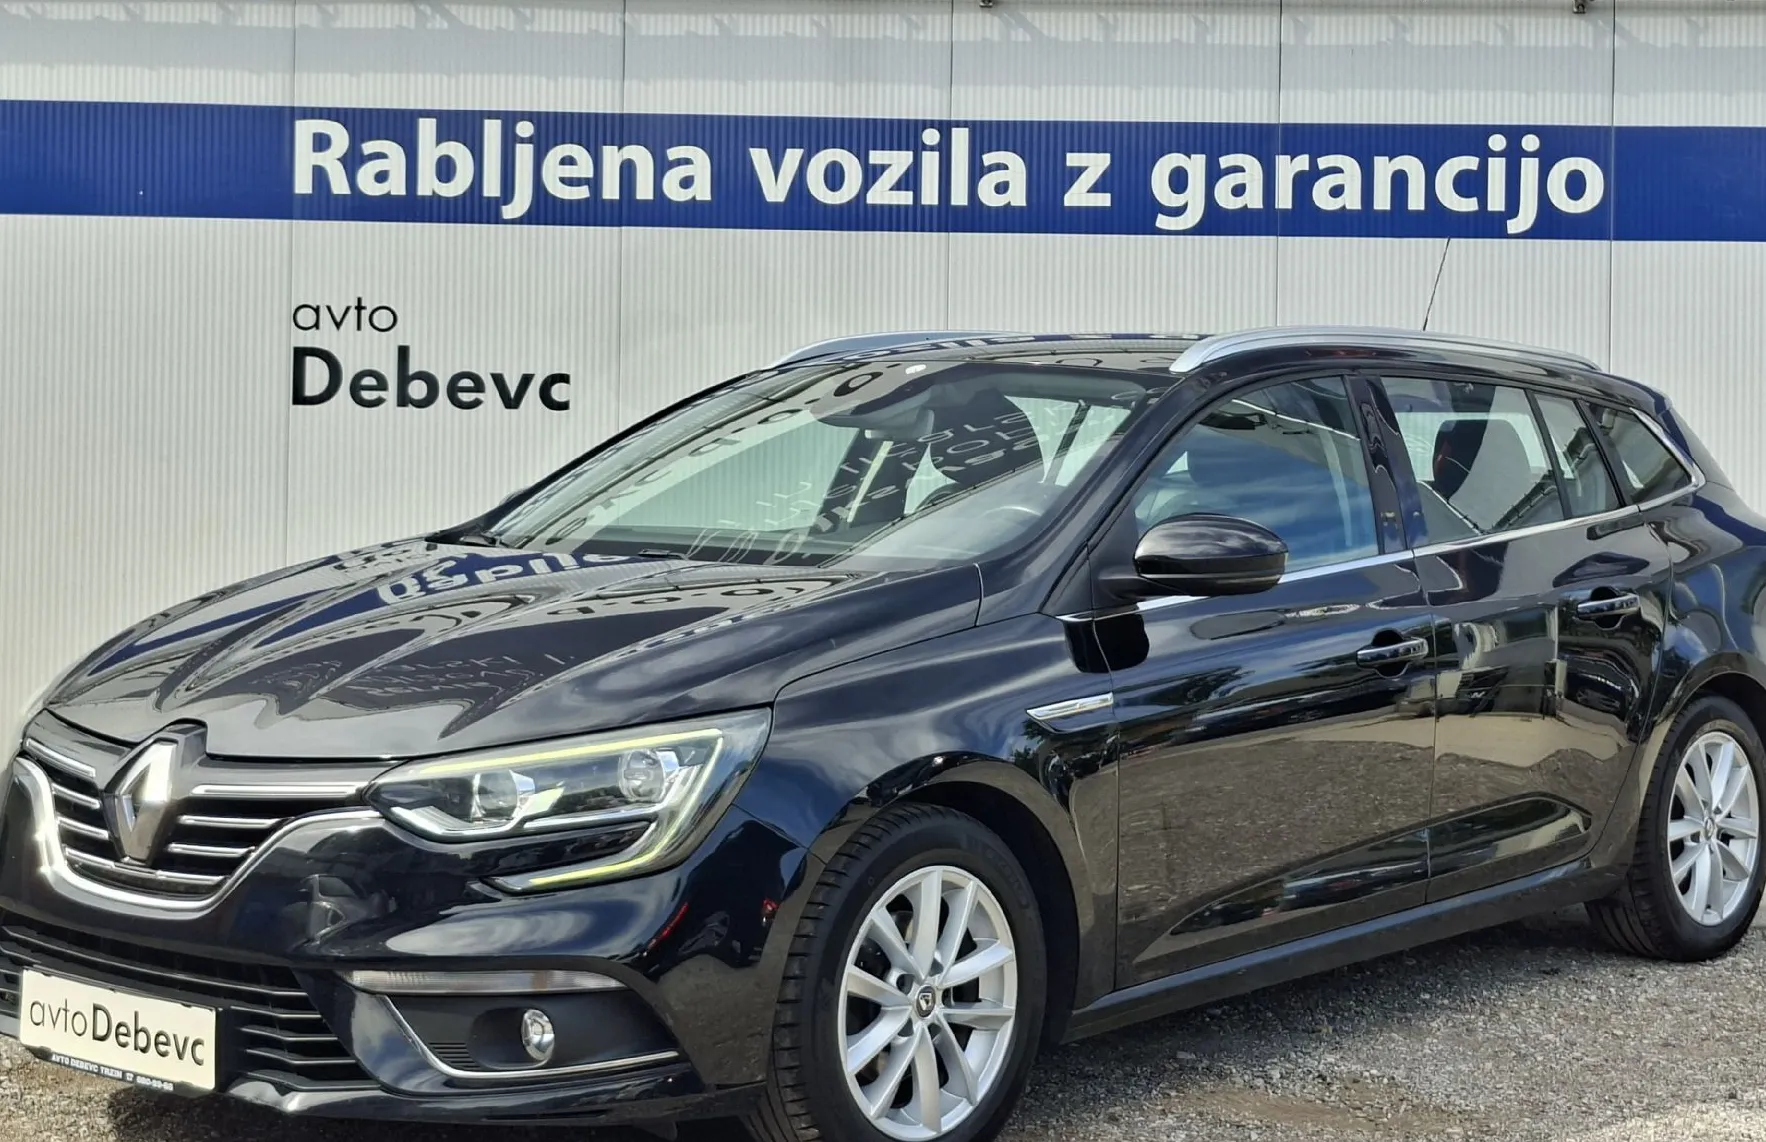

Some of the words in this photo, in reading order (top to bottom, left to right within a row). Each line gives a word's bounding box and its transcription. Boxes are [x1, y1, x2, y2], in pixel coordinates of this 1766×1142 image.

[293, 117, 713, 220] Rabljena
[749, 127, 1028, 207] vozila
[1063, 152, 1112, 207] z
[1151, 133, 1605, 235] garancijo
[293, 297, 398, 332] avto
[292, 345, 571, 411] Debevc
[29, 998, 205, 1066] avtoDebevc
